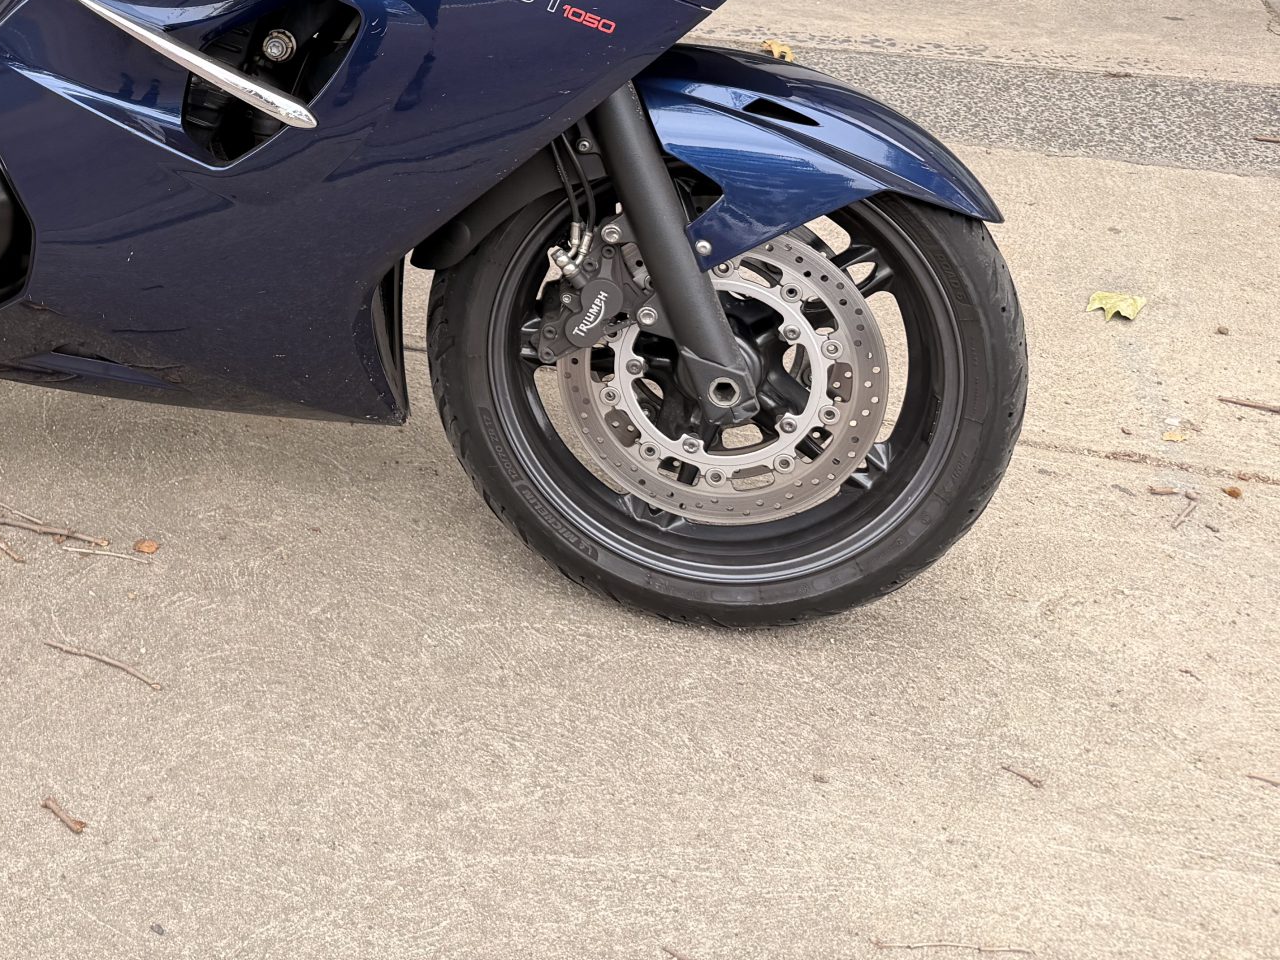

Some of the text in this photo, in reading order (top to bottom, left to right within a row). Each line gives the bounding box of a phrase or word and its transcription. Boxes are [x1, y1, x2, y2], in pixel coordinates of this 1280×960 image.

[562, 4, 616, 34] 1050
[572, 290, 609, 337] TRIUMPH
[495, 444, 519, 480] 120/70
[522, 489, 580, 543] MICHELIN
